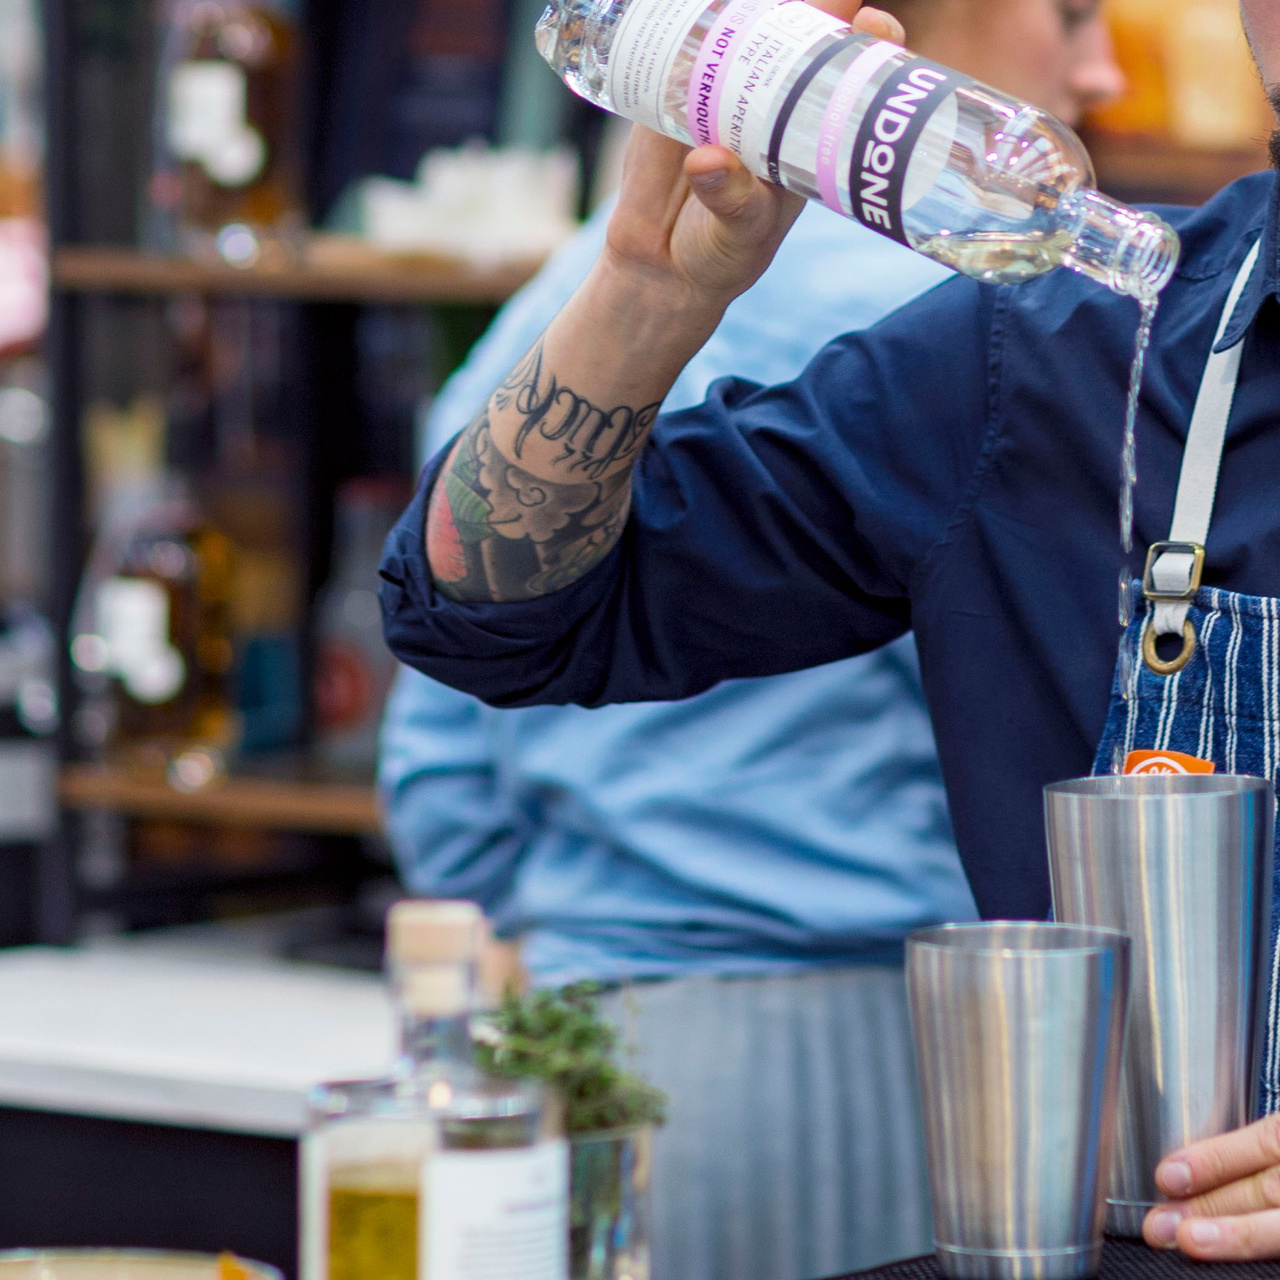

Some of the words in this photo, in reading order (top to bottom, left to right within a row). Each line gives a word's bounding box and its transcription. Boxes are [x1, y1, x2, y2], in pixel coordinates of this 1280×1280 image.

[728, 10, 746, 26] IS
[709, 25, 736, 60] NOT
[737, 30, 769, 66] TYPE
[741, 38, 783, 93] ITALIAN
[860, 68, 948, 230] UNDONE
